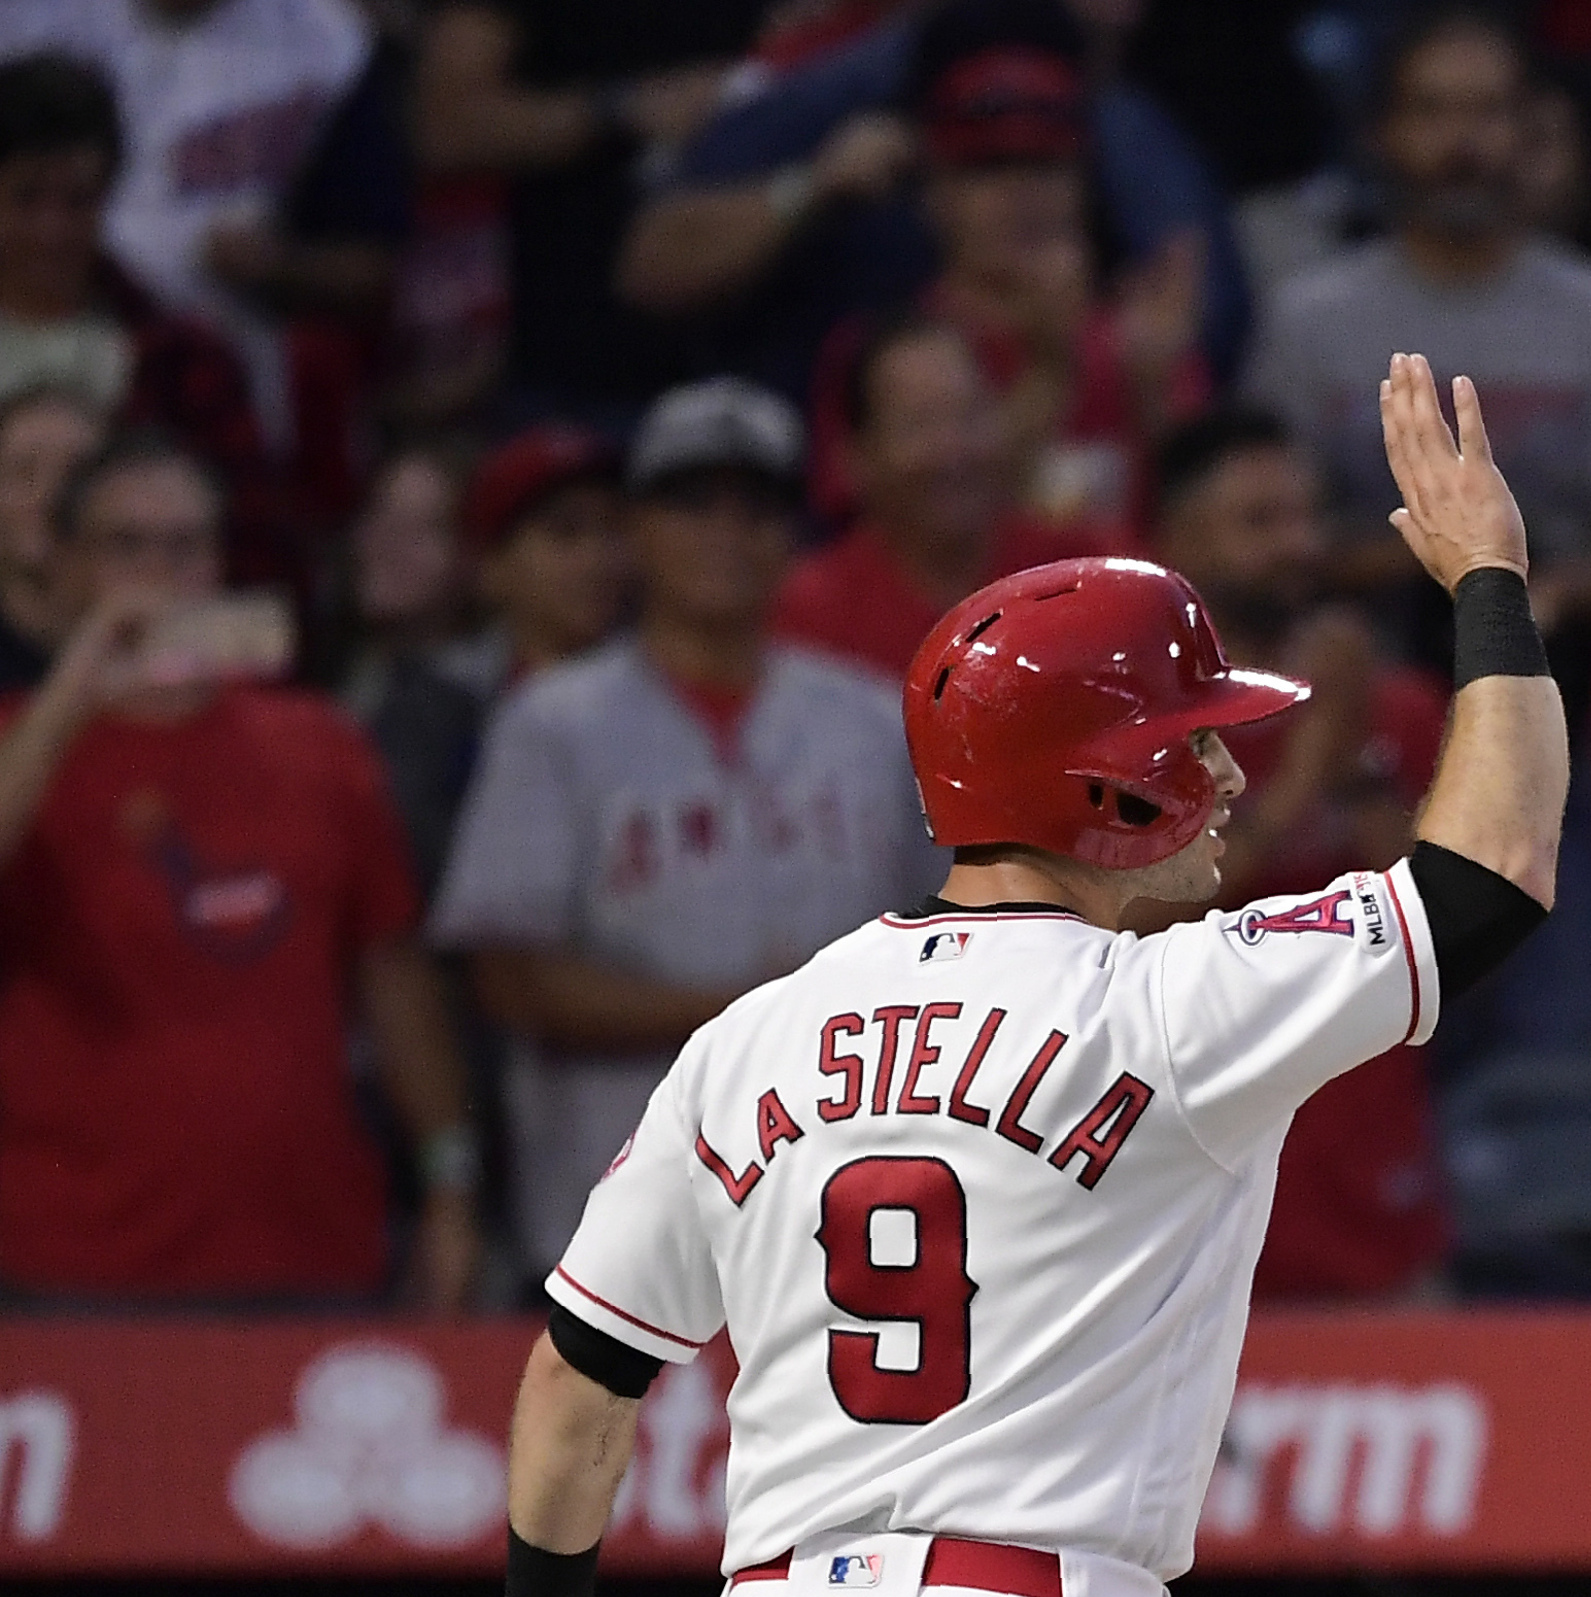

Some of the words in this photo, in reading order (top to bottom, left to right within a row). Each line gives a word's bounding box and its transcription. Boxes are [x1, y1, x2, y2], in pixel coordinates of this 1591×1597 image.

[1363, 903, 1386, 945] MLB
[816, 1002, 1155, 1191] STELLA
[814, 1155, 980, 1426] 9
